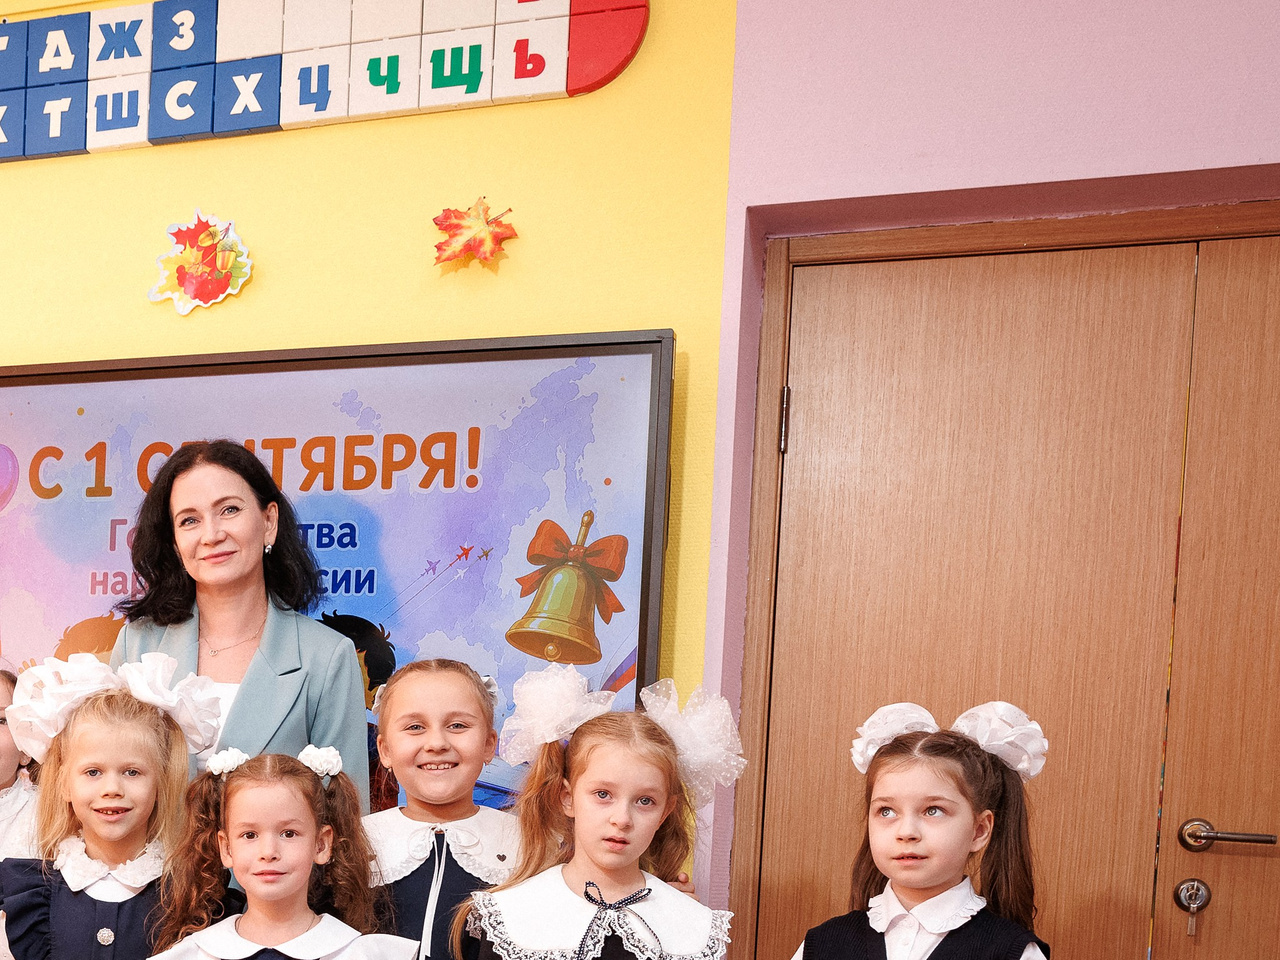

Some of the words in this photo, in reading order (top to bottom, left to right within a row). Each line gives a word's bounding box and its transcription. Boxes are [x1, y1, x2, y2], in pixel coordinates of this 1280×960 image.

[38, 29, 74, 72] Д
[96, 19, 142, 61] Ж
[43, 97, 71, 137] Т
[94, 89, 139, 131] Ш
[164, 80, 197, 120] С
[230, 72, 262, 115] Х
[297, 64, 331, 111] Ц
[366, 55, 400, 94] Ч
[430, 44, 482, 93] Щ
[29, 446, 63, 499] С
[85, 442, 113, 497] 1
[136, 426, 480, 495] СТЯБРЯ!
